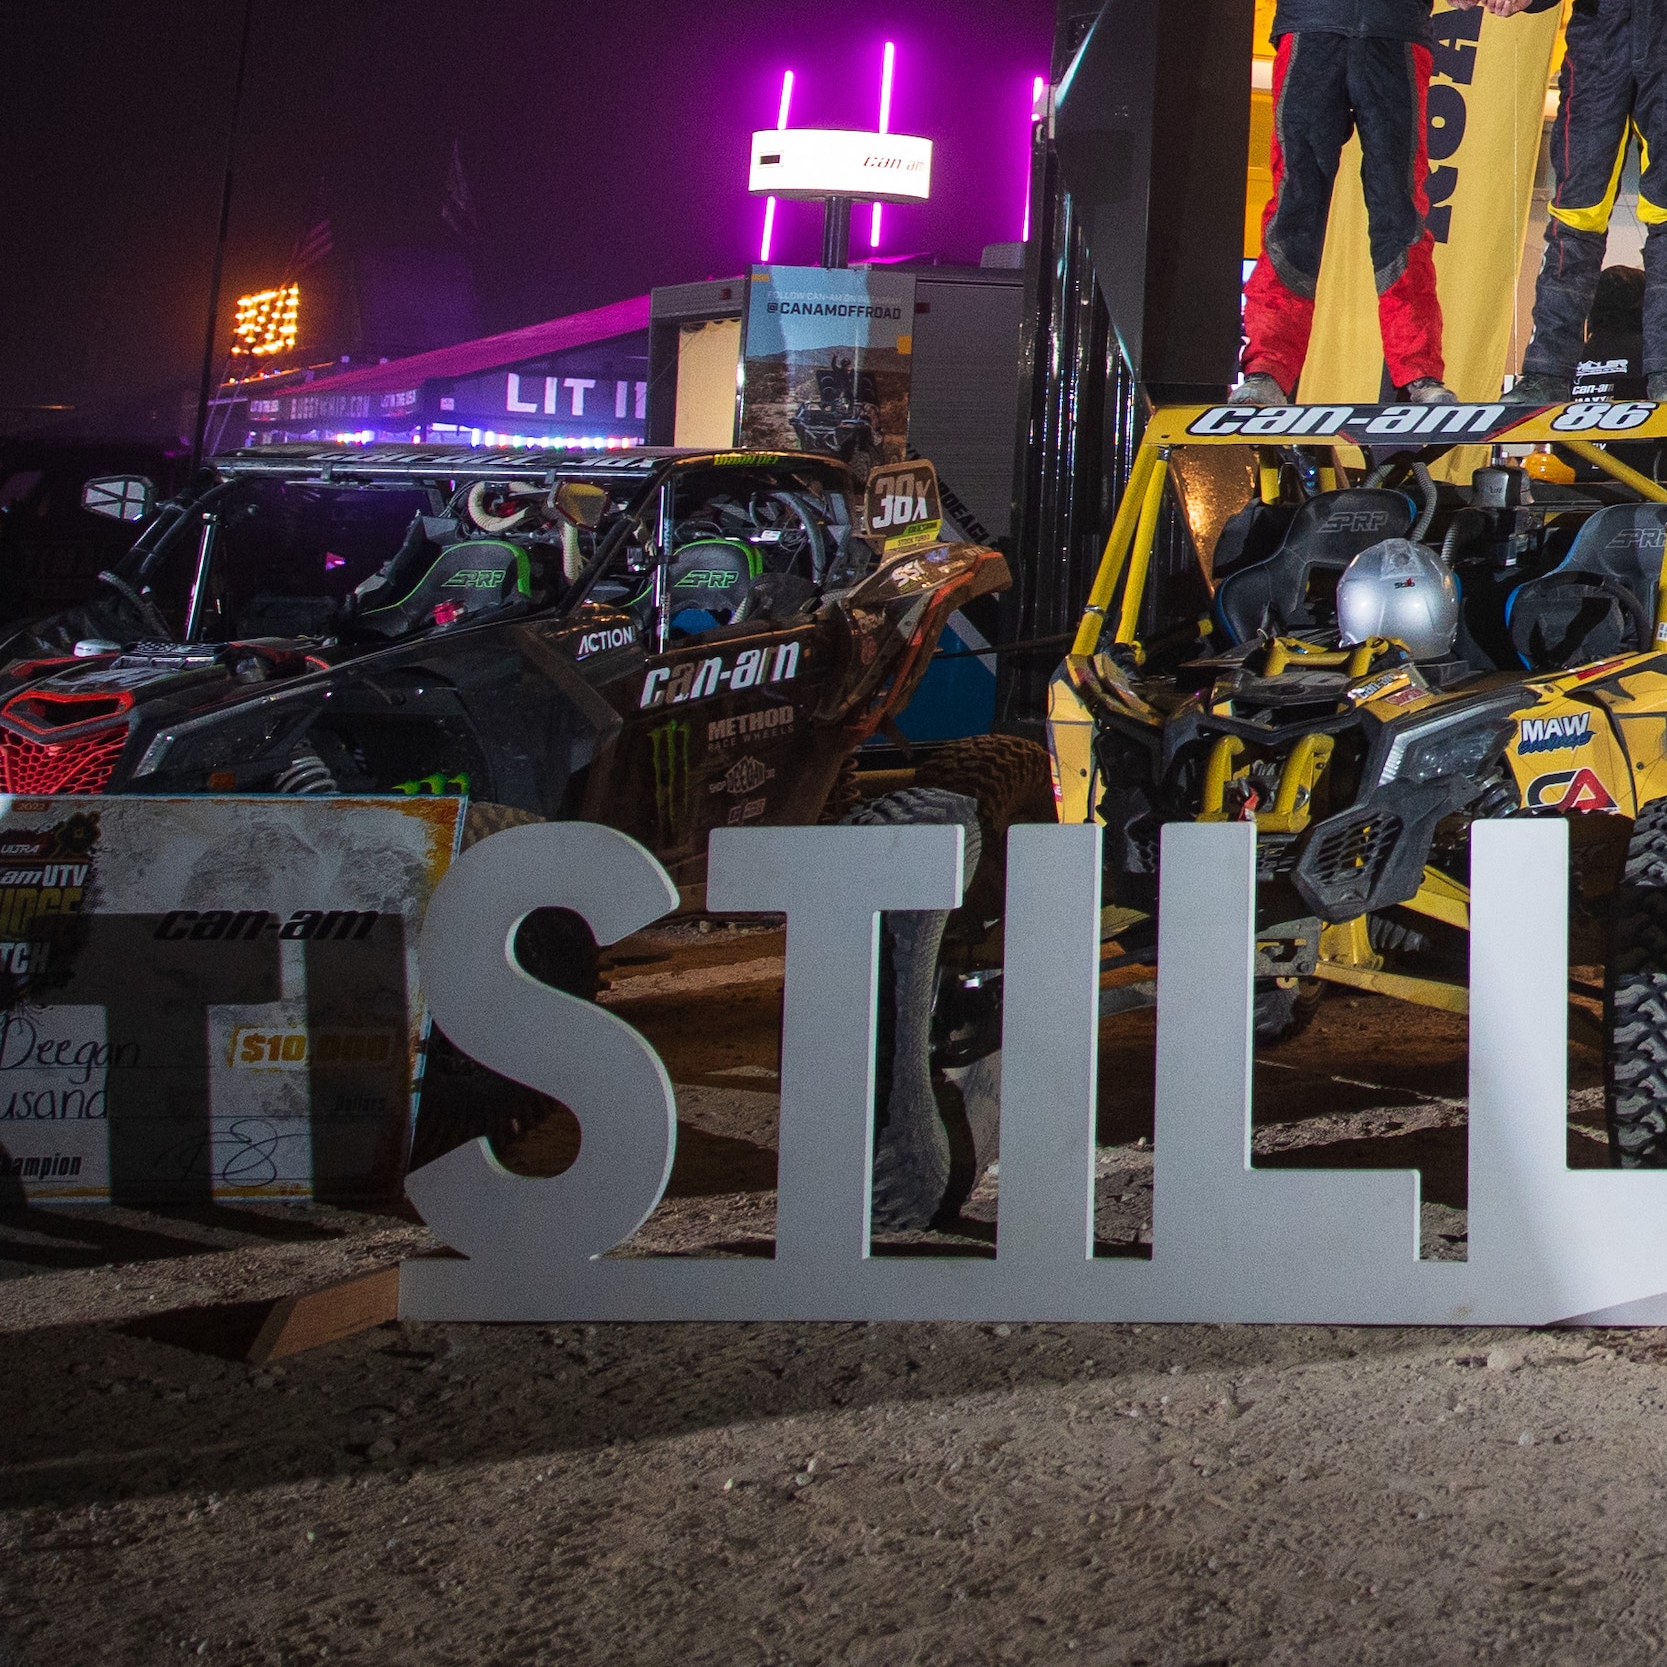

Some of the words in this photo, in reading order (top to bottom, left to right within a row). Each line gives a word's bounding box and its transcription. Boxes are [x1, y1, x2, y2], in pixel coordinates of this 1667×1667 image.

[767, 302, 901, 320] @CANAMOFFROAD
[507, 373, 597, 417] LIT
[1572, 383, 1615, 395] can-am
[1190, 404, 1506, 436] can-am
[1550, 400, 1657, 431] 86
[1335, 510, 1390, 532] PRP
[577, 625, 636, 656] ACTION
[639, 641, 801, 710] can-am
[708, 705, 794, 741] METHOD
[1520, 711, 1591, 743] MAW
[708, 737, 737, 752] RACE
[743, 725, 794, 743] WHEELS
[17, 802, 45, 812] 2022
[43, 864, 90, 887] UTV
[153, 909, 380, 941] can-am
[240, 1034, 391, 1064] $10,000
[333, 1094, 387, 1113] Dollars
